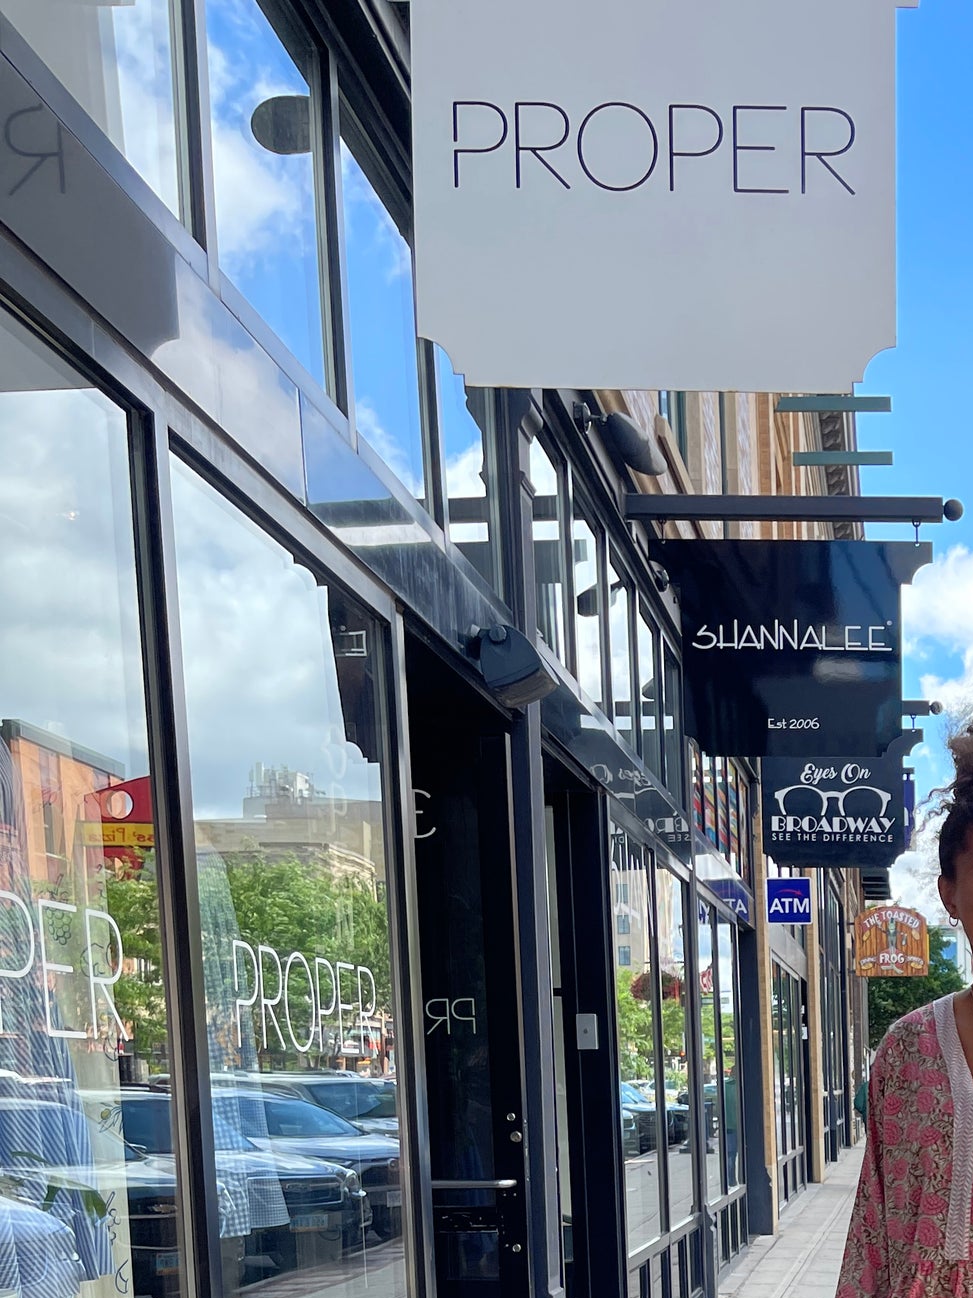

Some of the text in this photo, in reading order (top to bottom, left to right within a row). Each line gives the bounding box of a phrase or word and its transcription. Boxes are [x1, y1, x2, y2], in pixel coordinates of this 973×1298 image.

[452, 101, 857, 196] PROPER
[691, 618, 893, 651] SHANNALEE
[767, 717, 820, 729] Est 2006
[800, 763, 871, 785] Eyes On
[771, 815, 896, 833] BROADWAY
[771, 832, 894, 843] SEE THE DIFFERENCE
[769, 897, 810, 914] ATM
[863, 910, 920, 929] THE TOASTED
[879, 953, 905, 964] FROG
[232, 939, 379, 1055] PROPER
